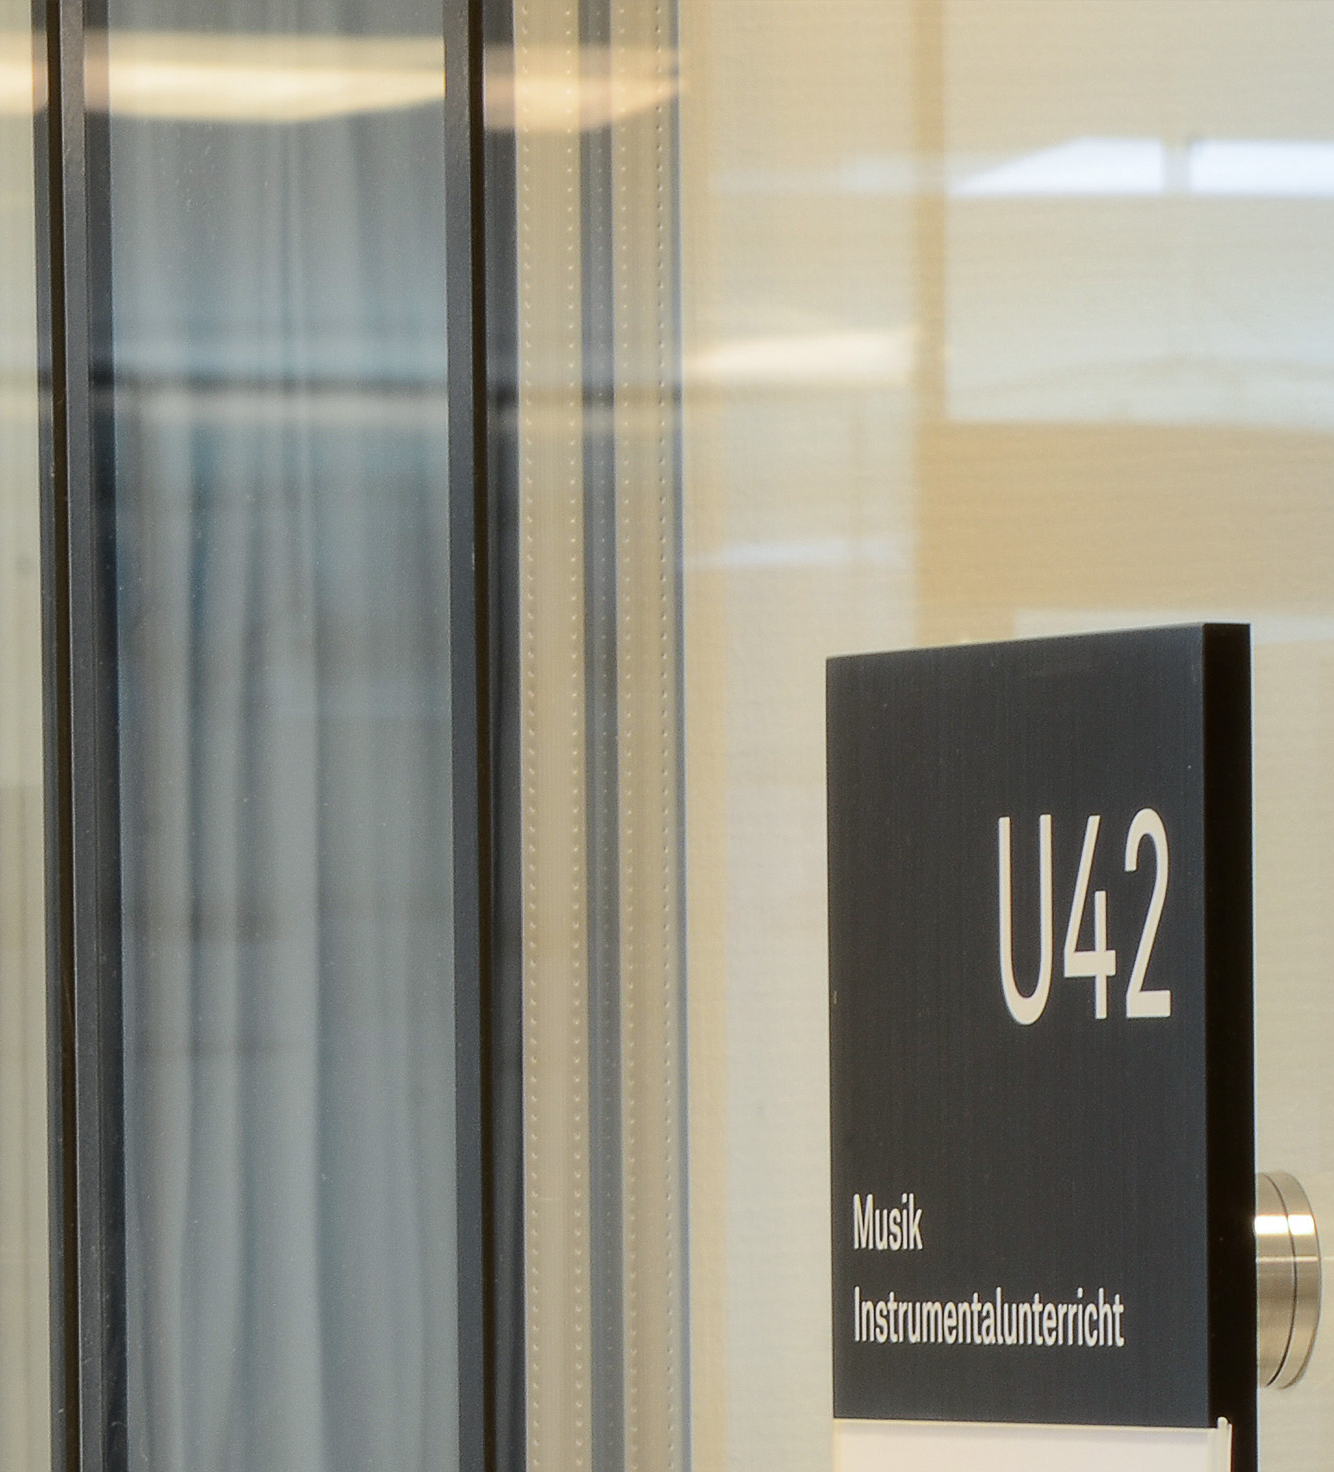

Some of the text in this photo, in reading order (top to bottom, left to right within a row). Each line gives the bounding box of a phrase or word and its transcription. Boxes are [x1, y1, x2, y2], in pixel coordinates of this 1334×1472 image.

[998, 808, 1171, 1025] U42
[853, 1193, 922, 1250] Musik
[855, 1287, 1124, 1347] Instrumentalunterricht
